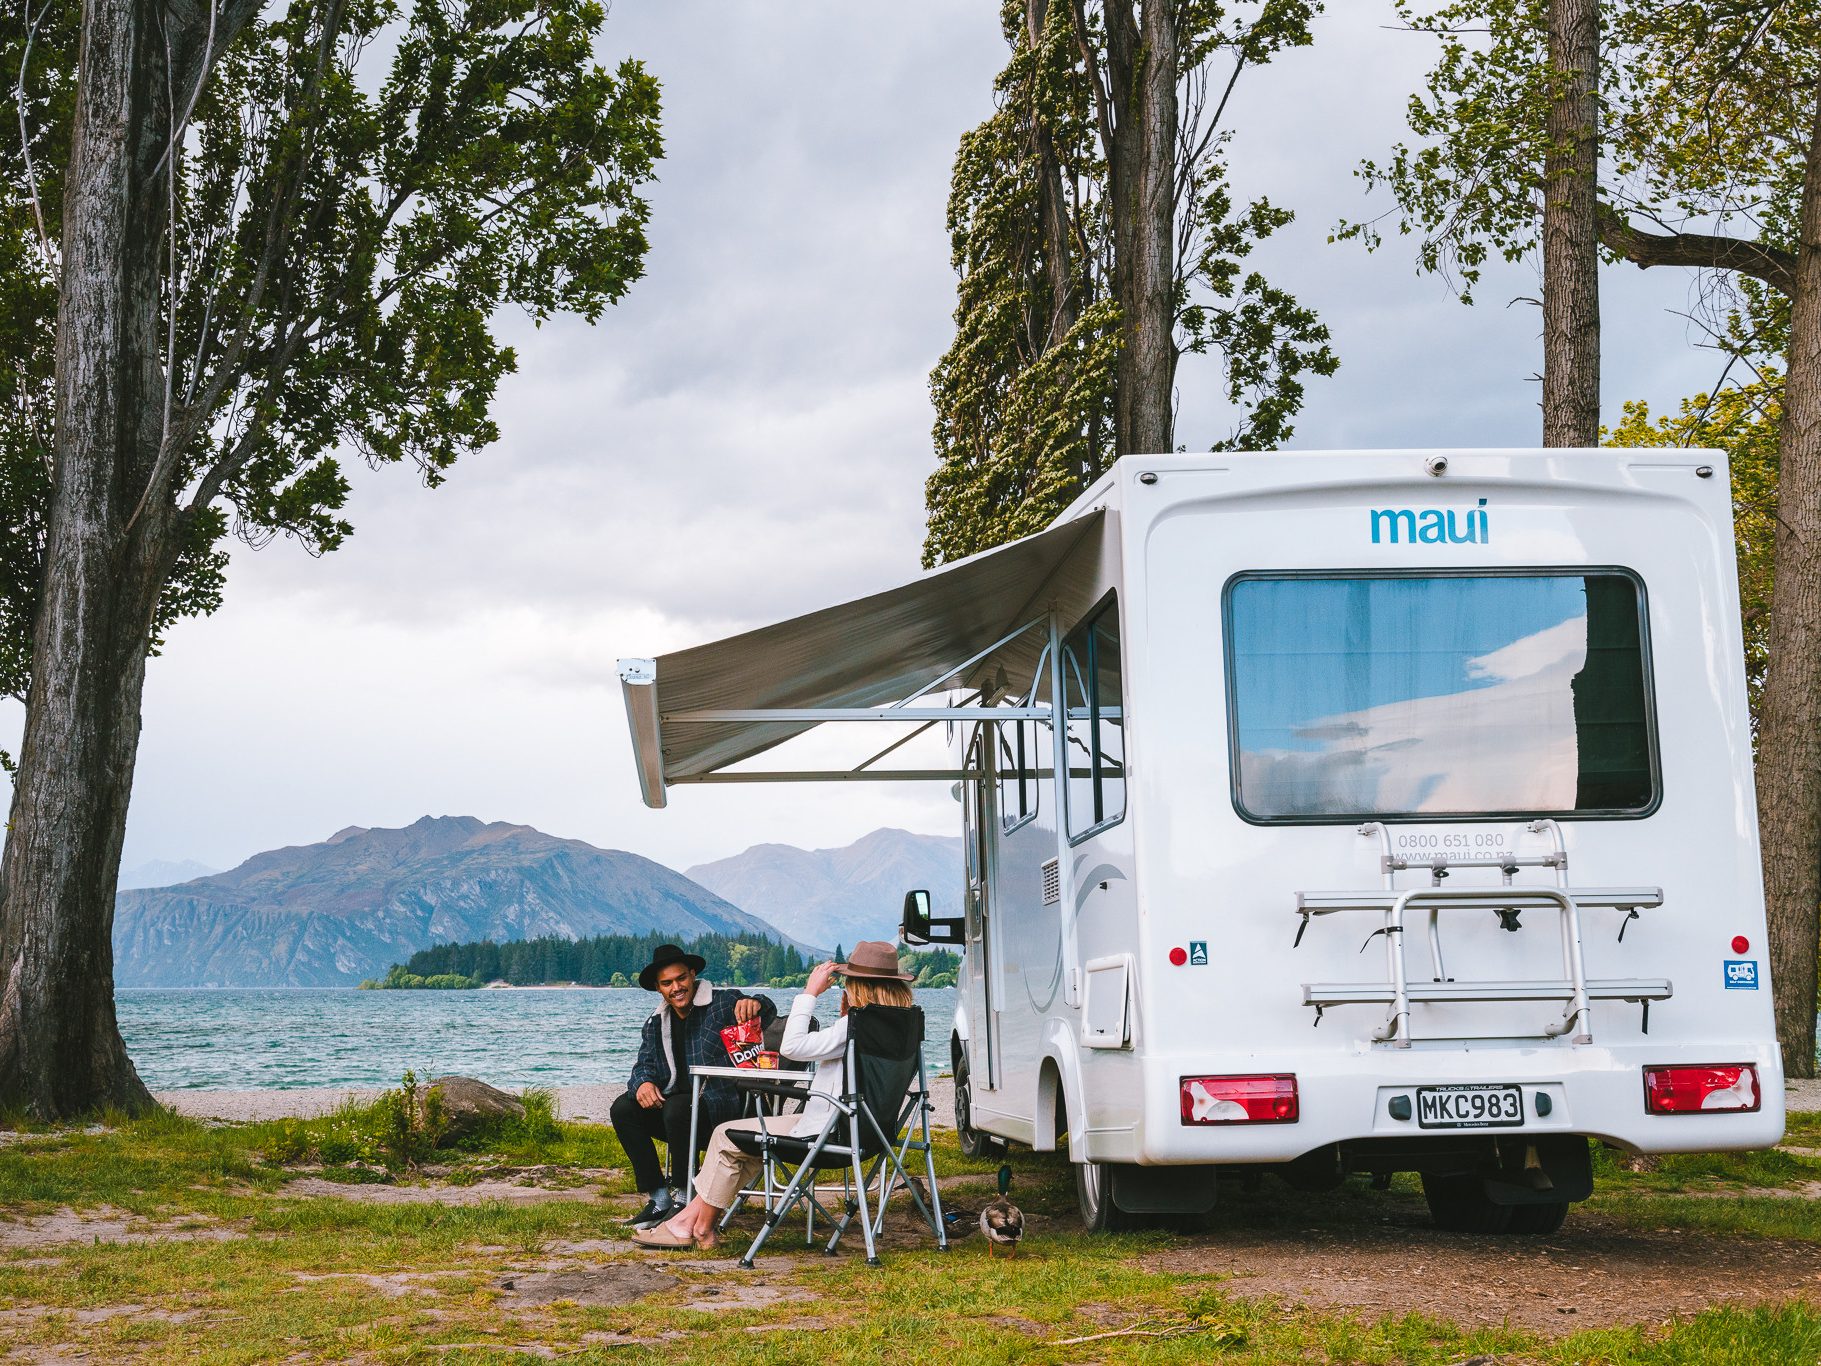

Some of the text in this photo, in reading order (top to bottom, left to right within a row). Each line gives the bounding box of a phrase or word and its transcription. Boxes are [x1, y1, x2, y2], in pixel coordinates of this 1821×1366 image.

[1370, 498, 1489, 544] maui
[1399, 833, 1504, 848] 0800 651 080
[1395, 849, 1513, 861] wwwmauiconz
[1422, 1093, 1519, 1119] MKC983
